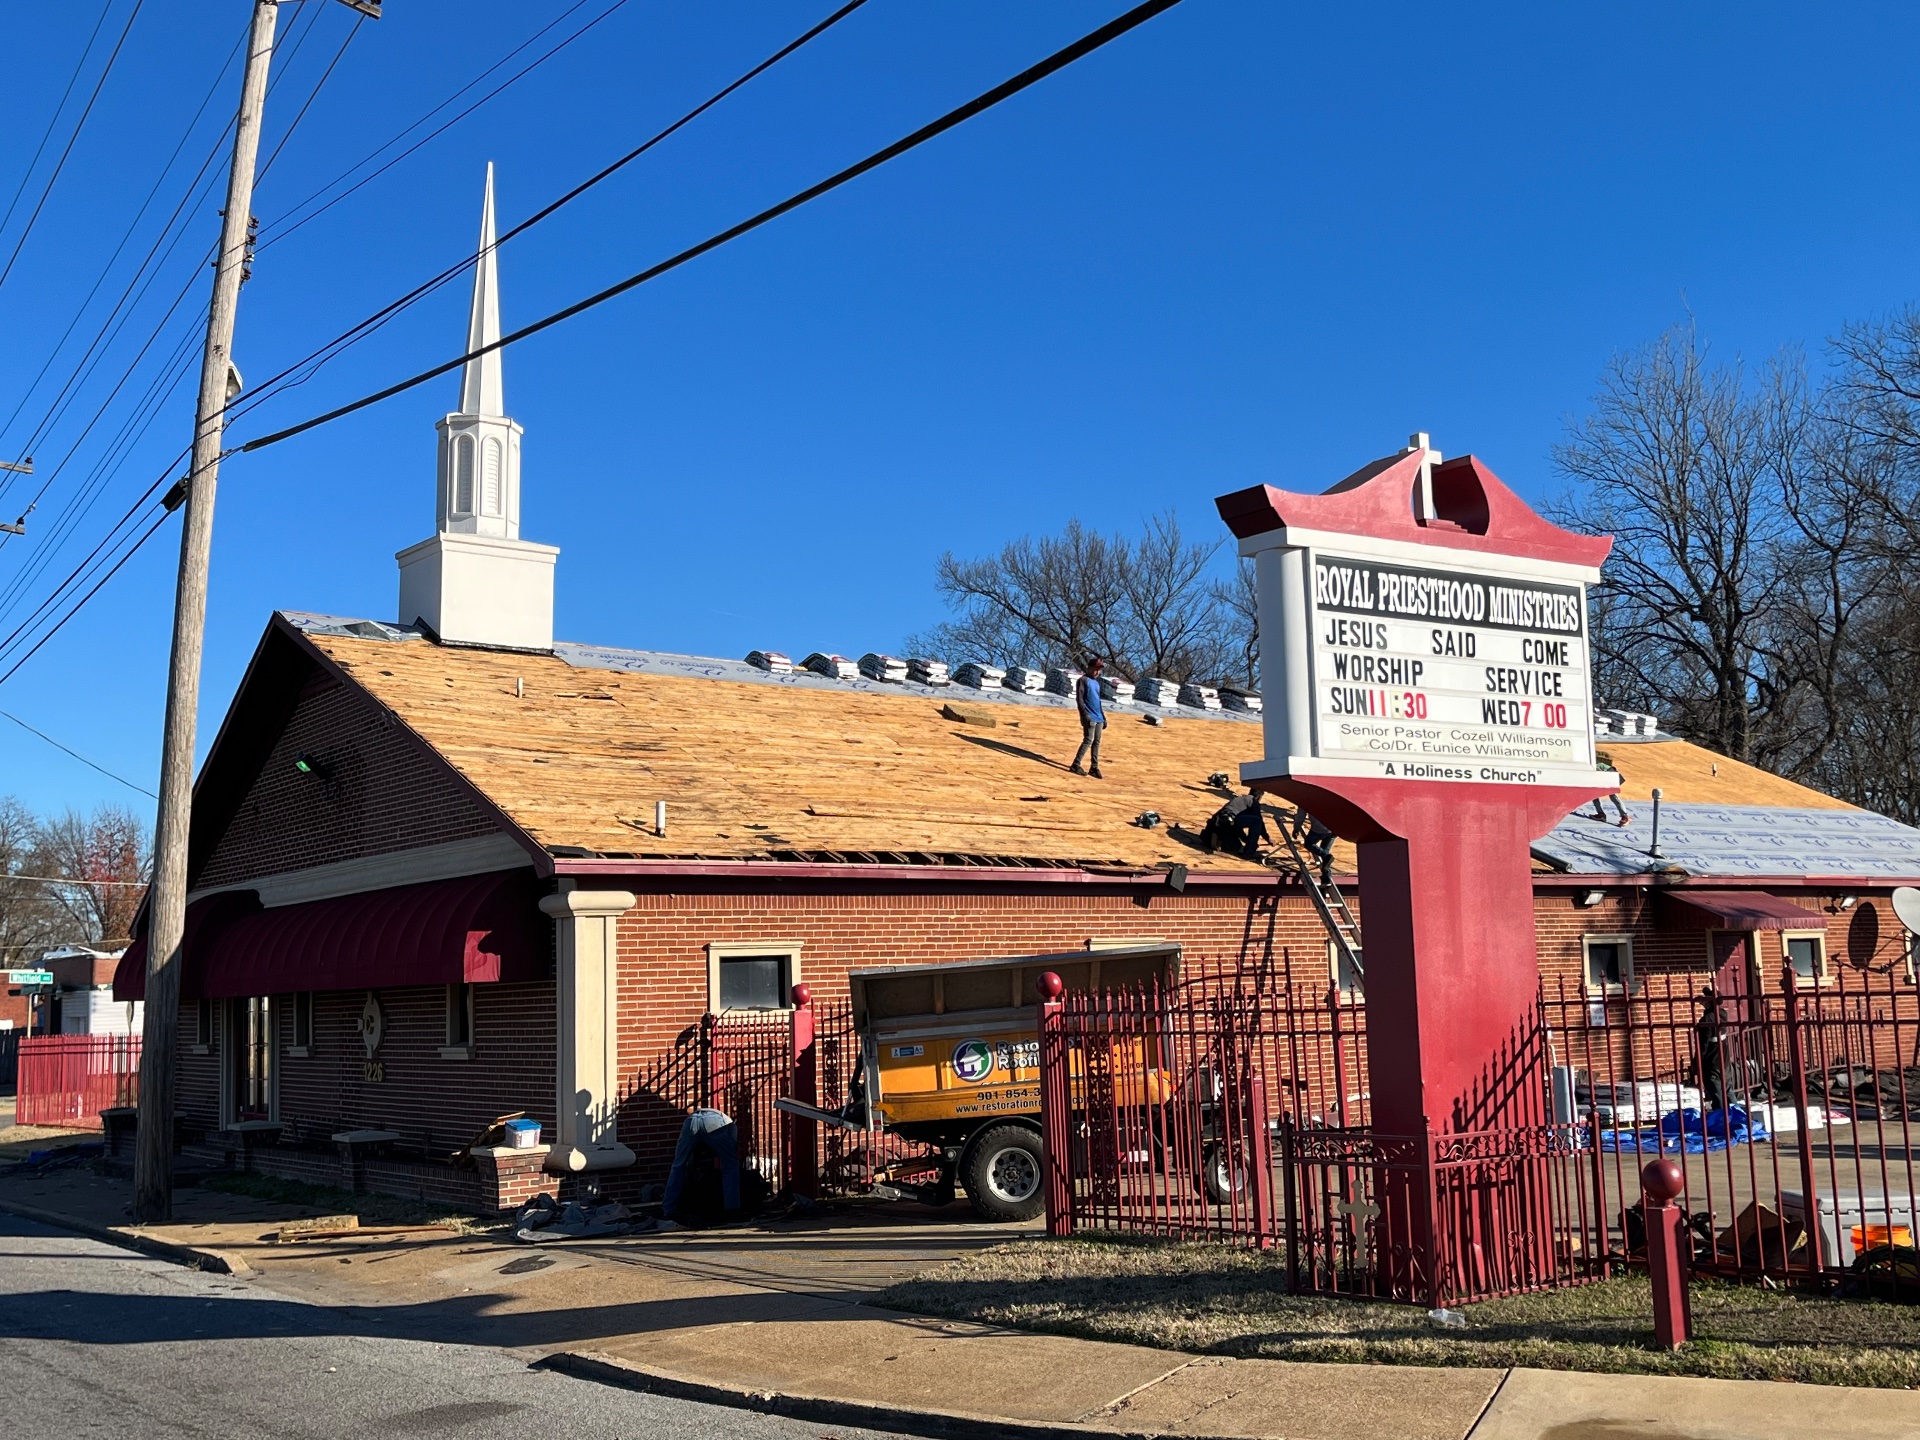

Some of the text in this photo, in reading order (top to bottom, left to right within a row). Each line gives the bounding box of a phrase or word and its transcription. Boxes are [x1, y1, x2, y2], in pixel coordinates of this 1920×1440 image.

[1316, 564, 1579, 631] ROYAL PRIESTHOOD MINISTRIES
[1326, 618, 1569, 666] JESUS SAID COME
[1333, 652, 1562, 697] WORSHIP SERVICE
[1341, 723, 1572, 748] Senior Pastor Cozell Williamson
[1369, 738, 1549, 758] Co/Dr. Eunice Williamson
[1403, 763, 1473, 779] Holiness
[996, 1040, 1040, 1055] Resto
[977, 1087, 1041, 1100] 901.854.3
